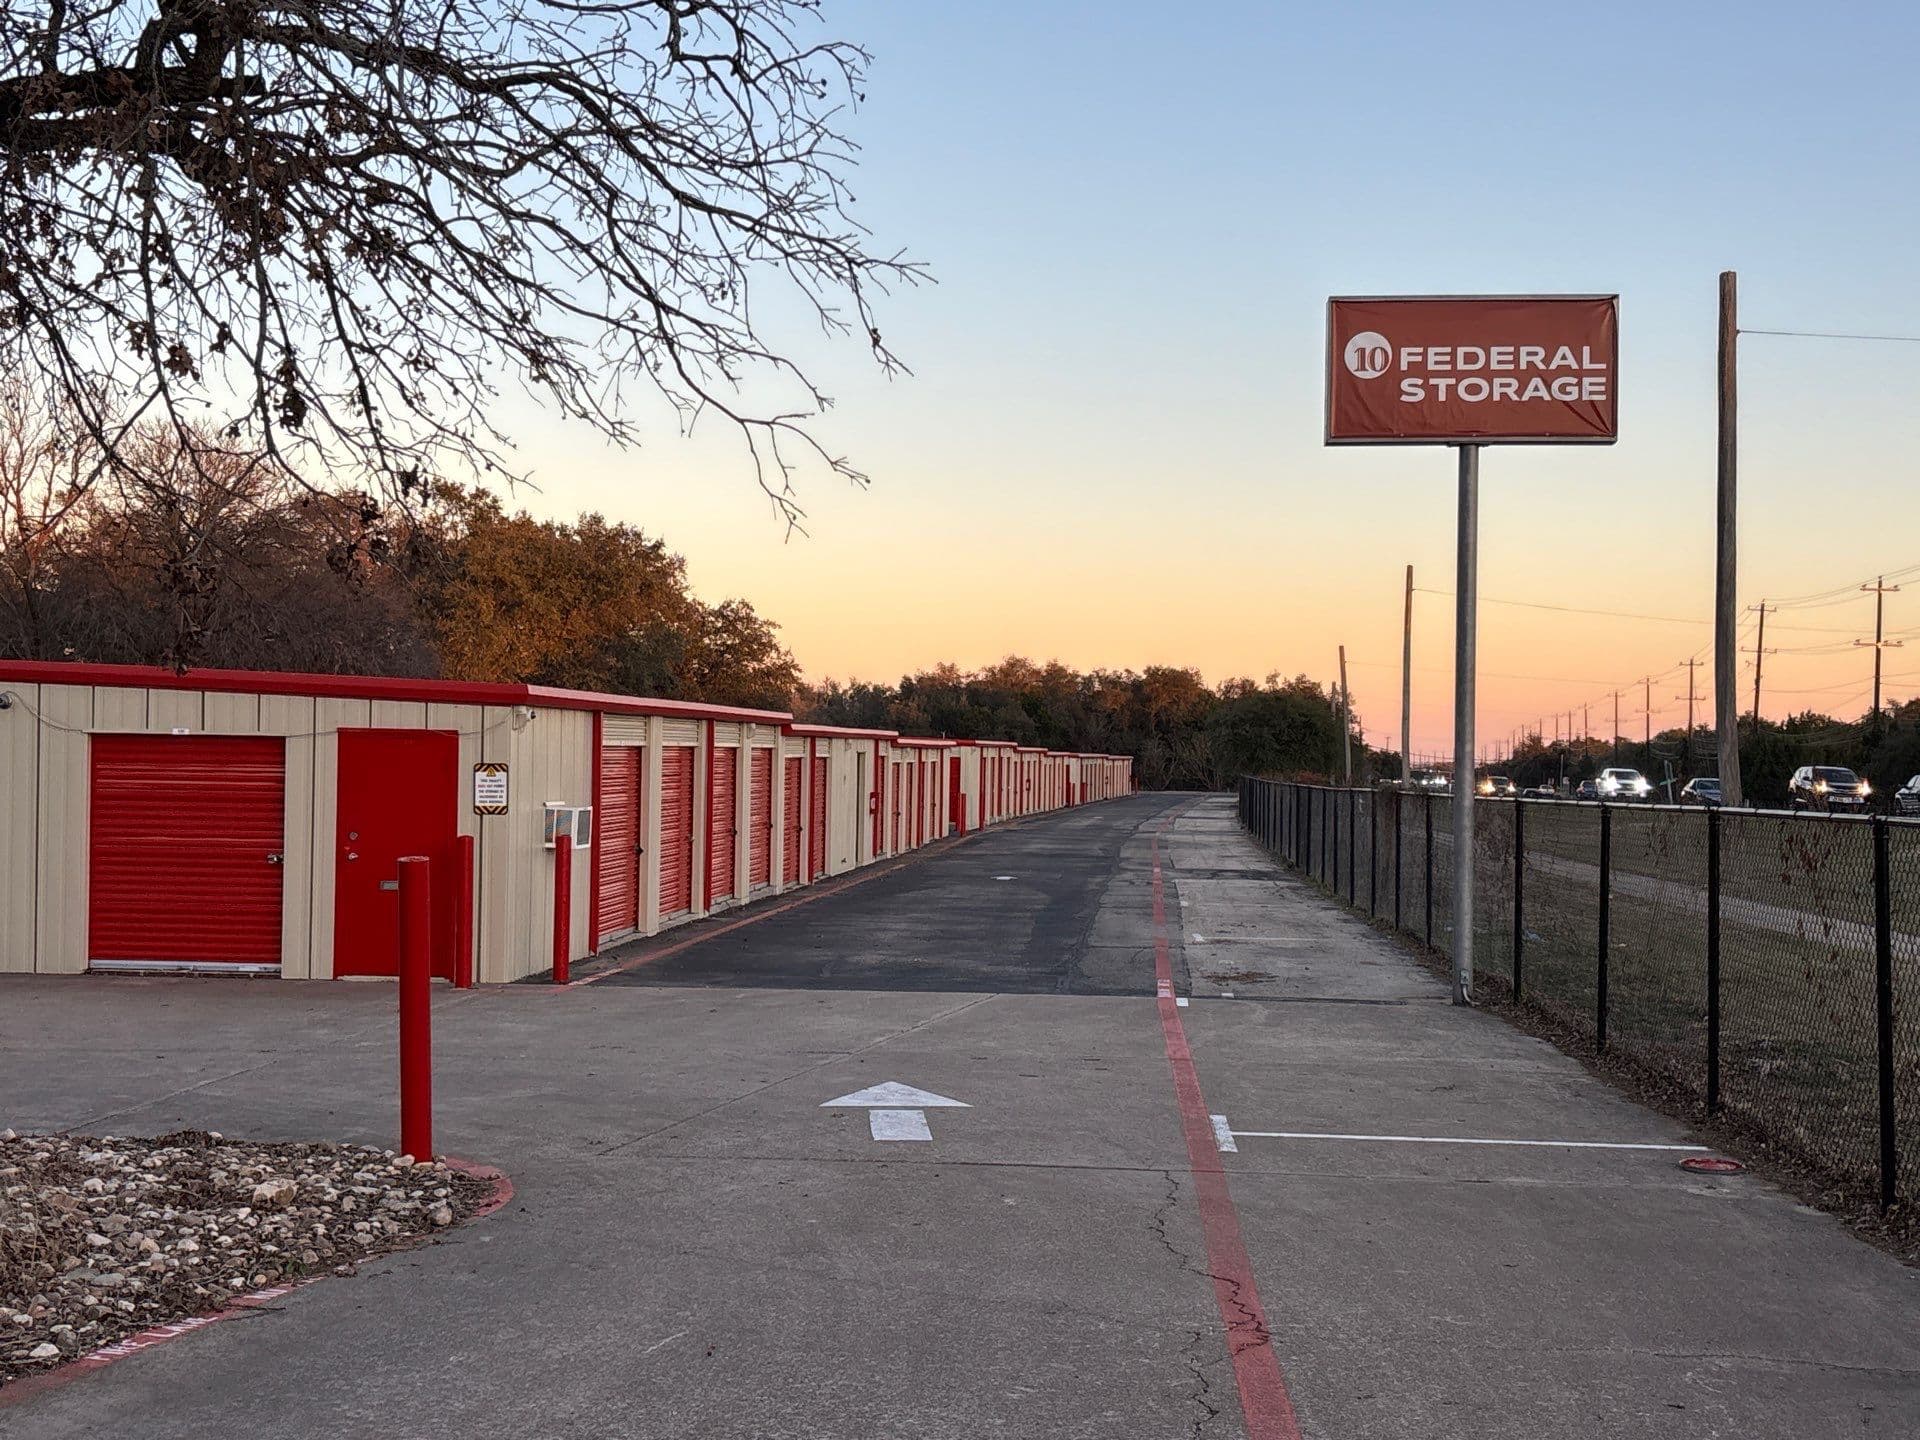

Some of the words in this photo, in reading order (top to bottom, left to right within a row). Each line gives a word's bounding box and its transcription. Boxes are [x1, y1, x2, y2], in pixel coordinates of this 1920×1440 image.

[1353, 346, 1390, 373] 10
[1400, 345, 1607, 371] FEDERAL
[1400, 376, 1607, 403] STORAGE
